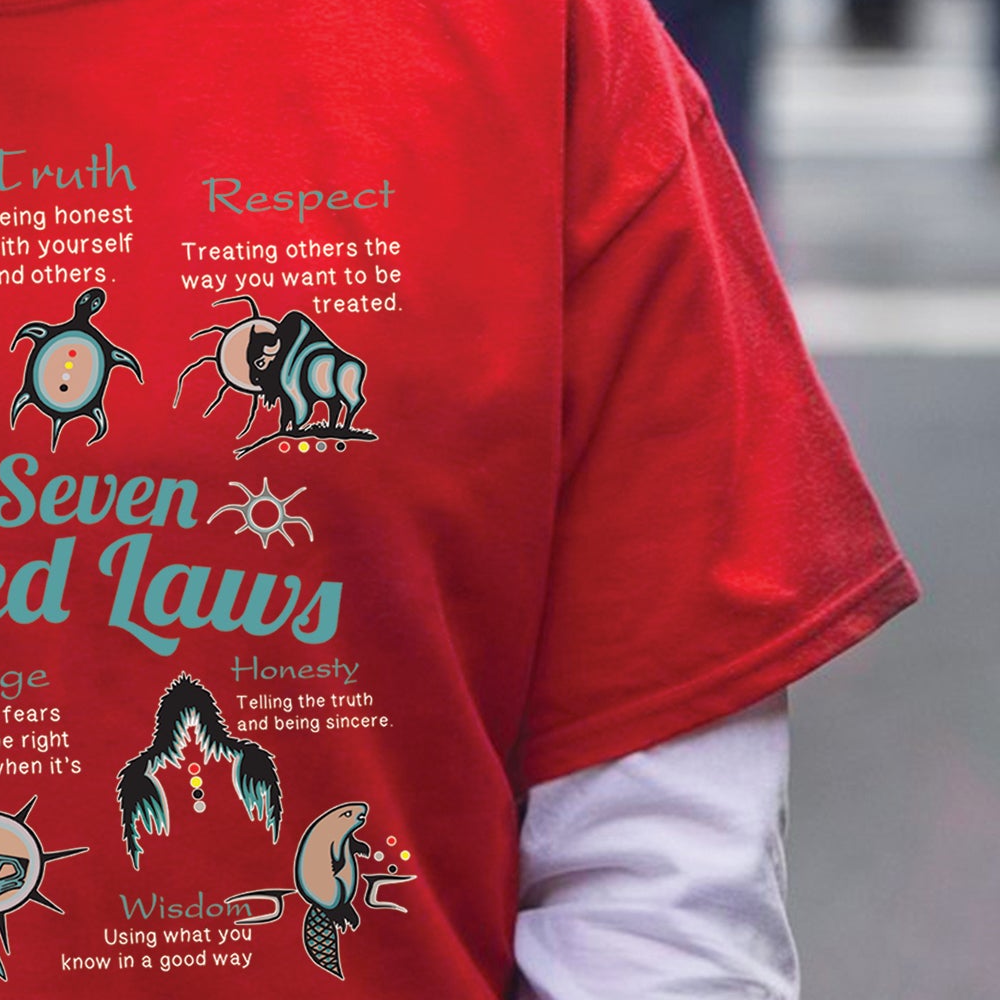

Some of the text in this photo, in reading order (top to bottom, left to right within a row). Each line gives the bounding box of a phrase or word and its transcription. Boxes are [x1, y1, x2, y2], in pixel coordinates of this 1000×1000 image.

[202, 178, 394, 223] Respect
[55, 205, 133, 224] honest
[38, 232, 133, 259] yourself
[181, 238, 400, 264] Treating others the
[181, 265, 401, 292] way you want to be
[313, 292, 402, 314] treated.
[99, 533, 342, 656] Laws
[232, 656, 358, 684] Honesty
[236, 693, 373, 712] Telling the truth
[2, 705, 60, 723] fears
[238, 714, 393, 733] and being sincere.
[22, 731, 69, 752] right
[50, 757, 81, 774] it's
[120, 891, 253, 921] Wisdom
[104, 928, 251, 948] Using what you
[62, 950, 252, 972] know in a good way
